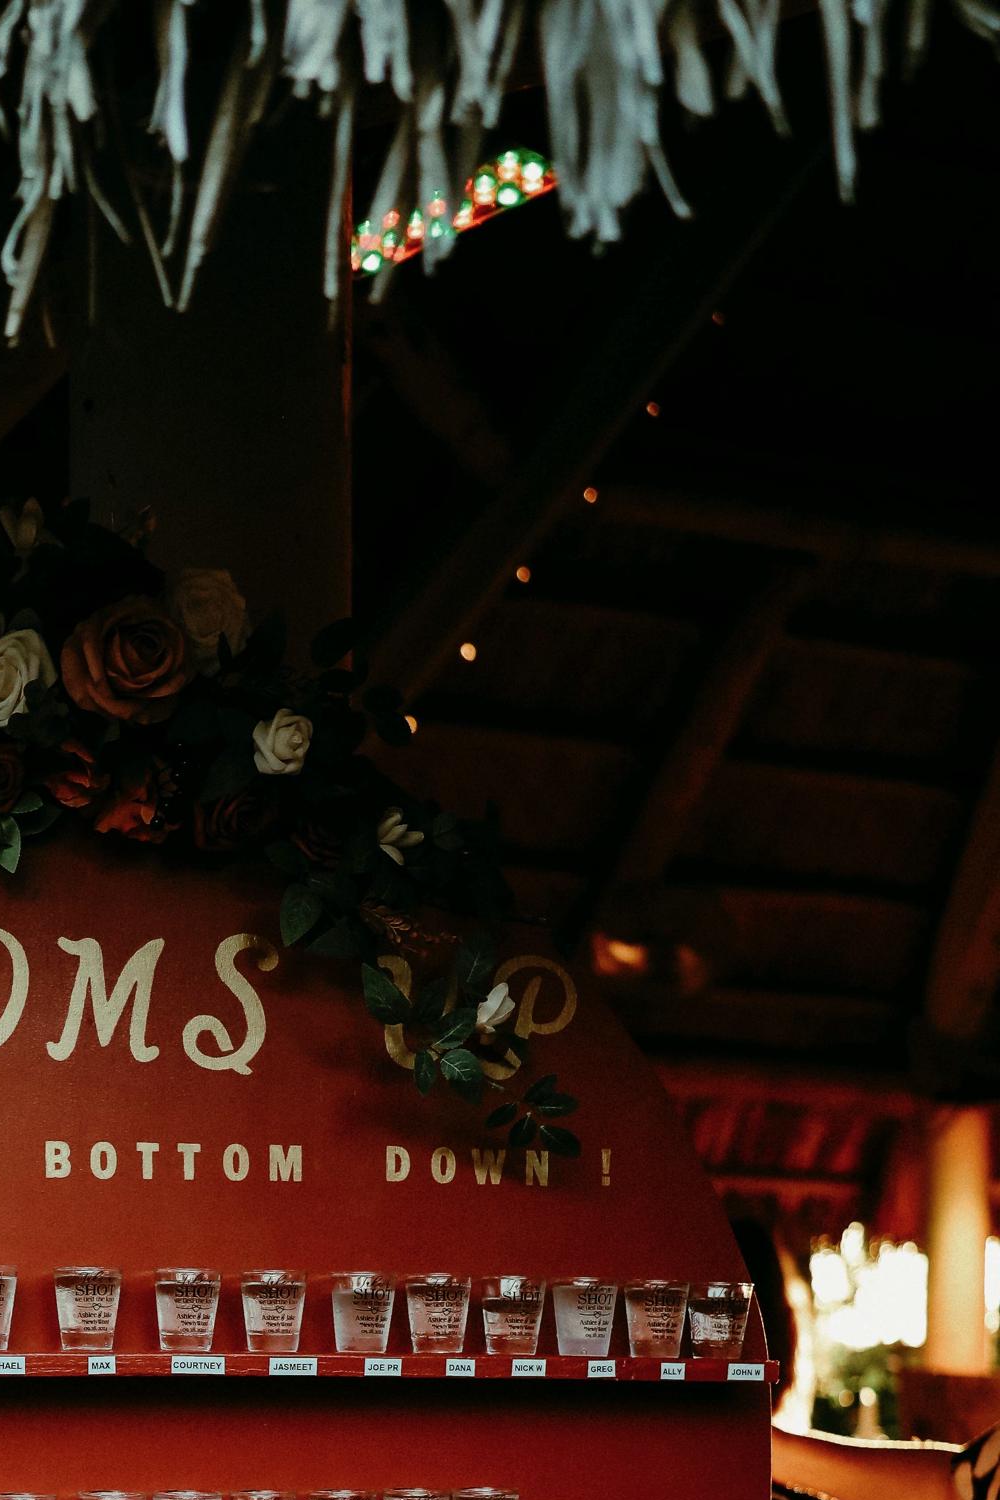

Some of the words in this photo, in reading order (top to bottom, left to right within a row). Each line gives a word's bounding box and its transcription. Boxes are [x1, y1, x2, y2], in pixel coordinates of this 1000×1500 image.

[45, 1140, 302, 1182] BOTTOM
[386, 1145, 549, 1186] DOWN
[601, 1148, 611, 1186] !
[577, 1293, 613, 1305] SHOT
[91, 1361, 111, 1370] MAX
[173, 1361, 222, 1370] COURTNEY
[272, 1363, 313, 1371] JASMEET
[367, 1363, 385, 1372] JOE
[387, 1364, 399, 1372] PR
[448, 1364, 472, 1372] DANA
[514, 1364, 535, 1372] NICK
[590, 1365, 613, 1373] GREG
[663, 1368, 683, 1376] ALLY
[731, 1368, 753, 1376] JOHN
